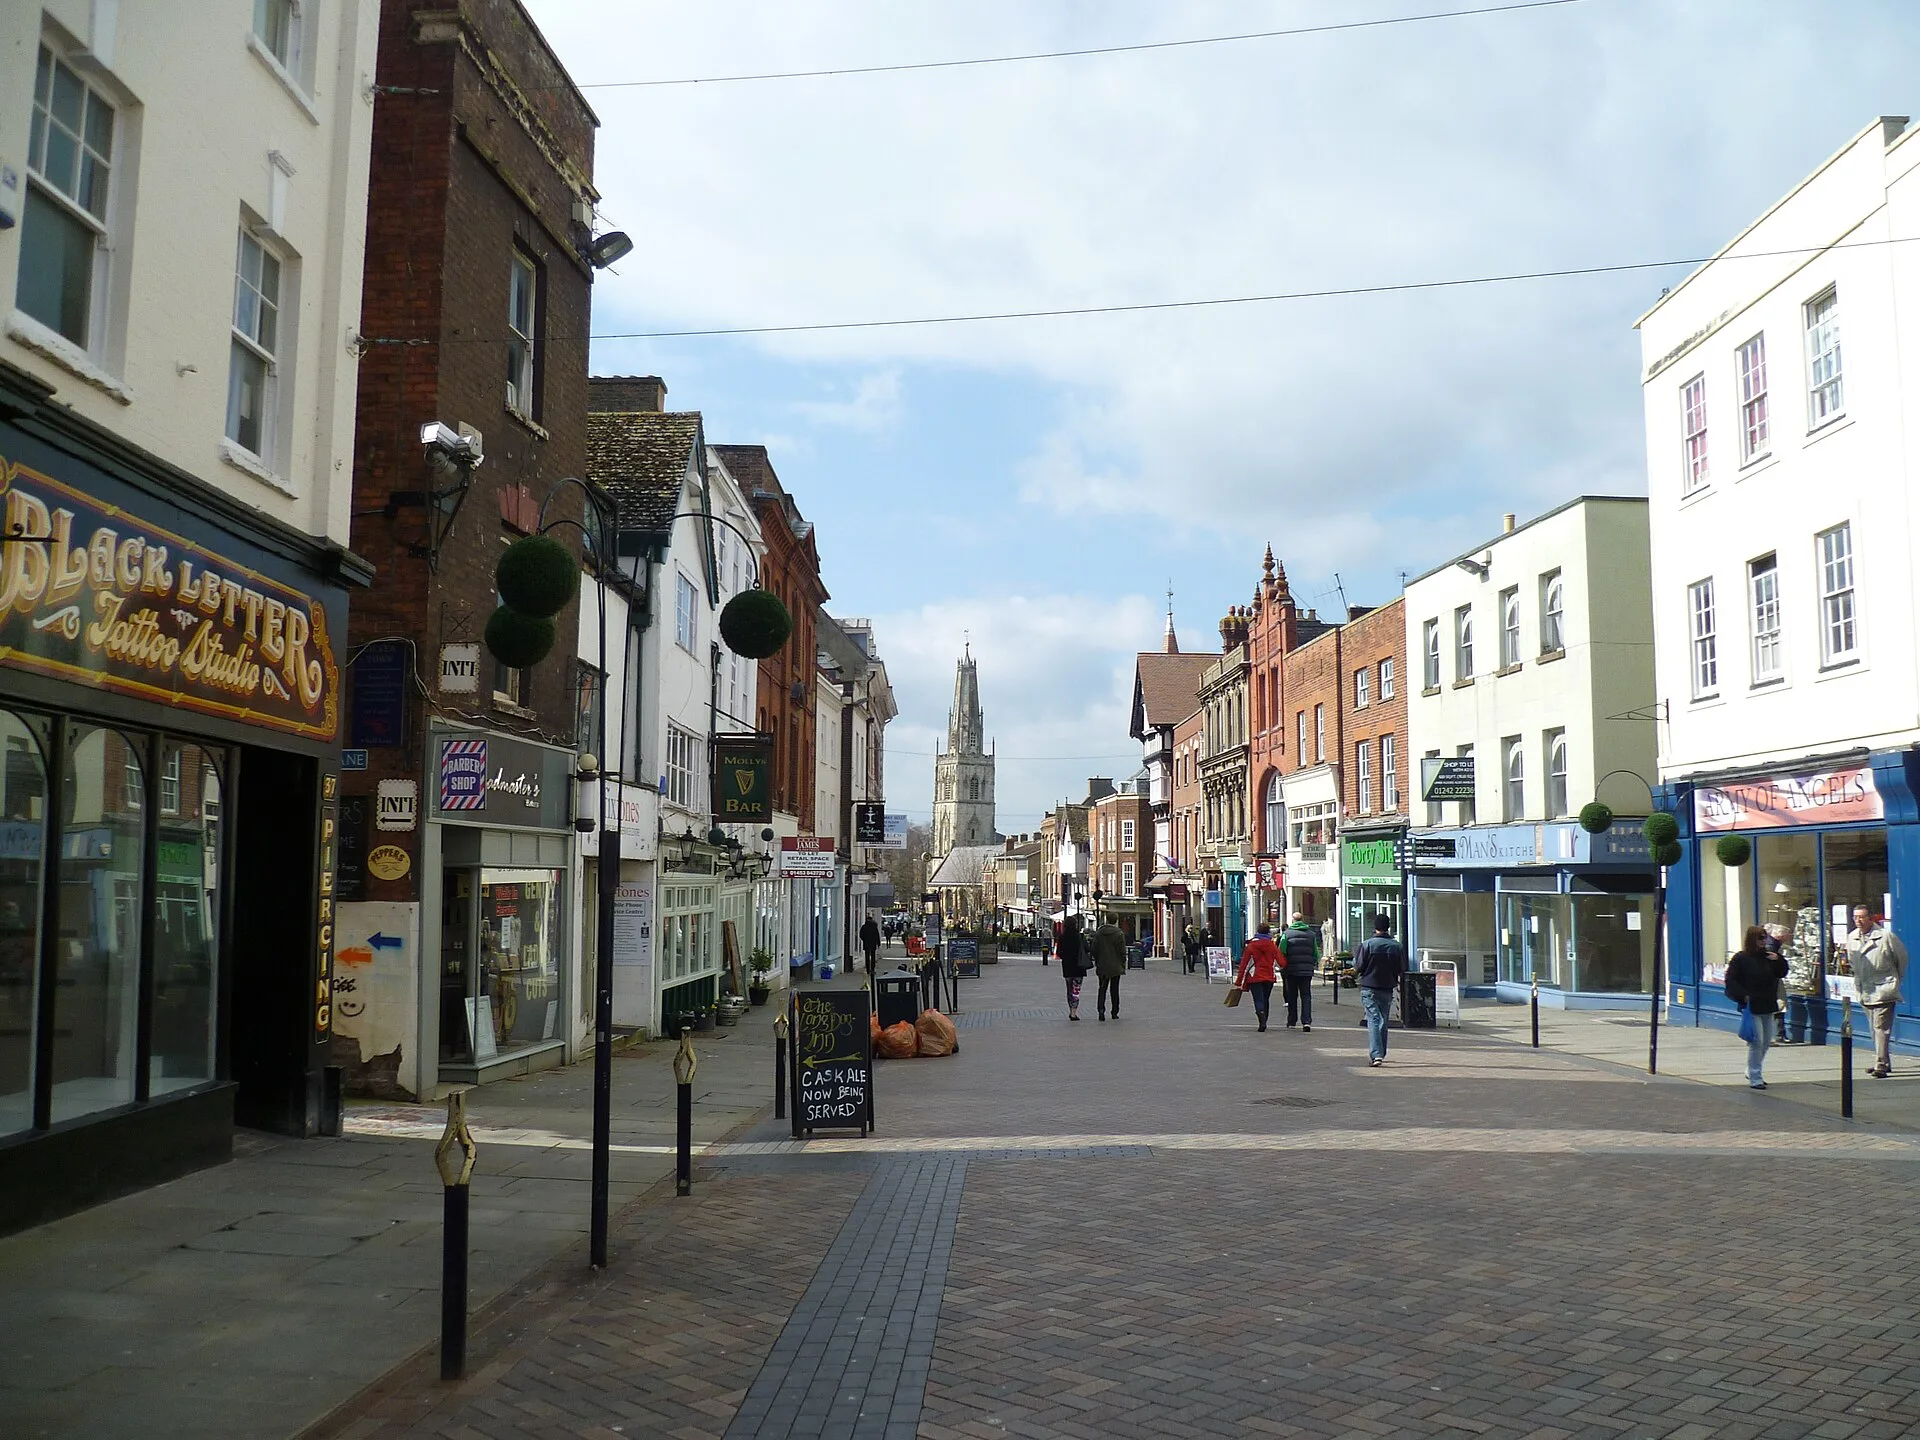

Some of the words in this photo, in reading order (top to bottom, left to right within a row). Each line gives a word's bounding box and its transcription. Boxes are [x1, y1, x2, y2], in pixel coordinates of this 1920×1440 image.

[0, 488, 174, 612] BLACK
[177, 560, 323, 706] LETTER
[88, 590, 180, 668] Tattoo
[181, 618, 261, 694] Studio
[448, 758, 480, 774] BARBER
[324, 777, 336, 794] 37
[451, 777, 476, 790] SHOP
[1434, 787, 1454, 795] 01242
[1704, 787, 1751, 817] ARMY
[1755, 784, 1779, 812] OF
[1784, 773, 1866, 809] ANGELS
[726, 799, 762, 812] BAR
[796, 842, 820, 850] JAMES
[1350, 841, 1376, 868] Forty
[315, 818, 334, 1029] PIERCING
[802, 1068, 844, 1087] CASK
[847, 1067, 867, 1083] ALE
[803, 1088, 832, 1103] NOW
[837, 1085, 864, 1105] BEING
[806, 1103, 856, 1121] SERVED
